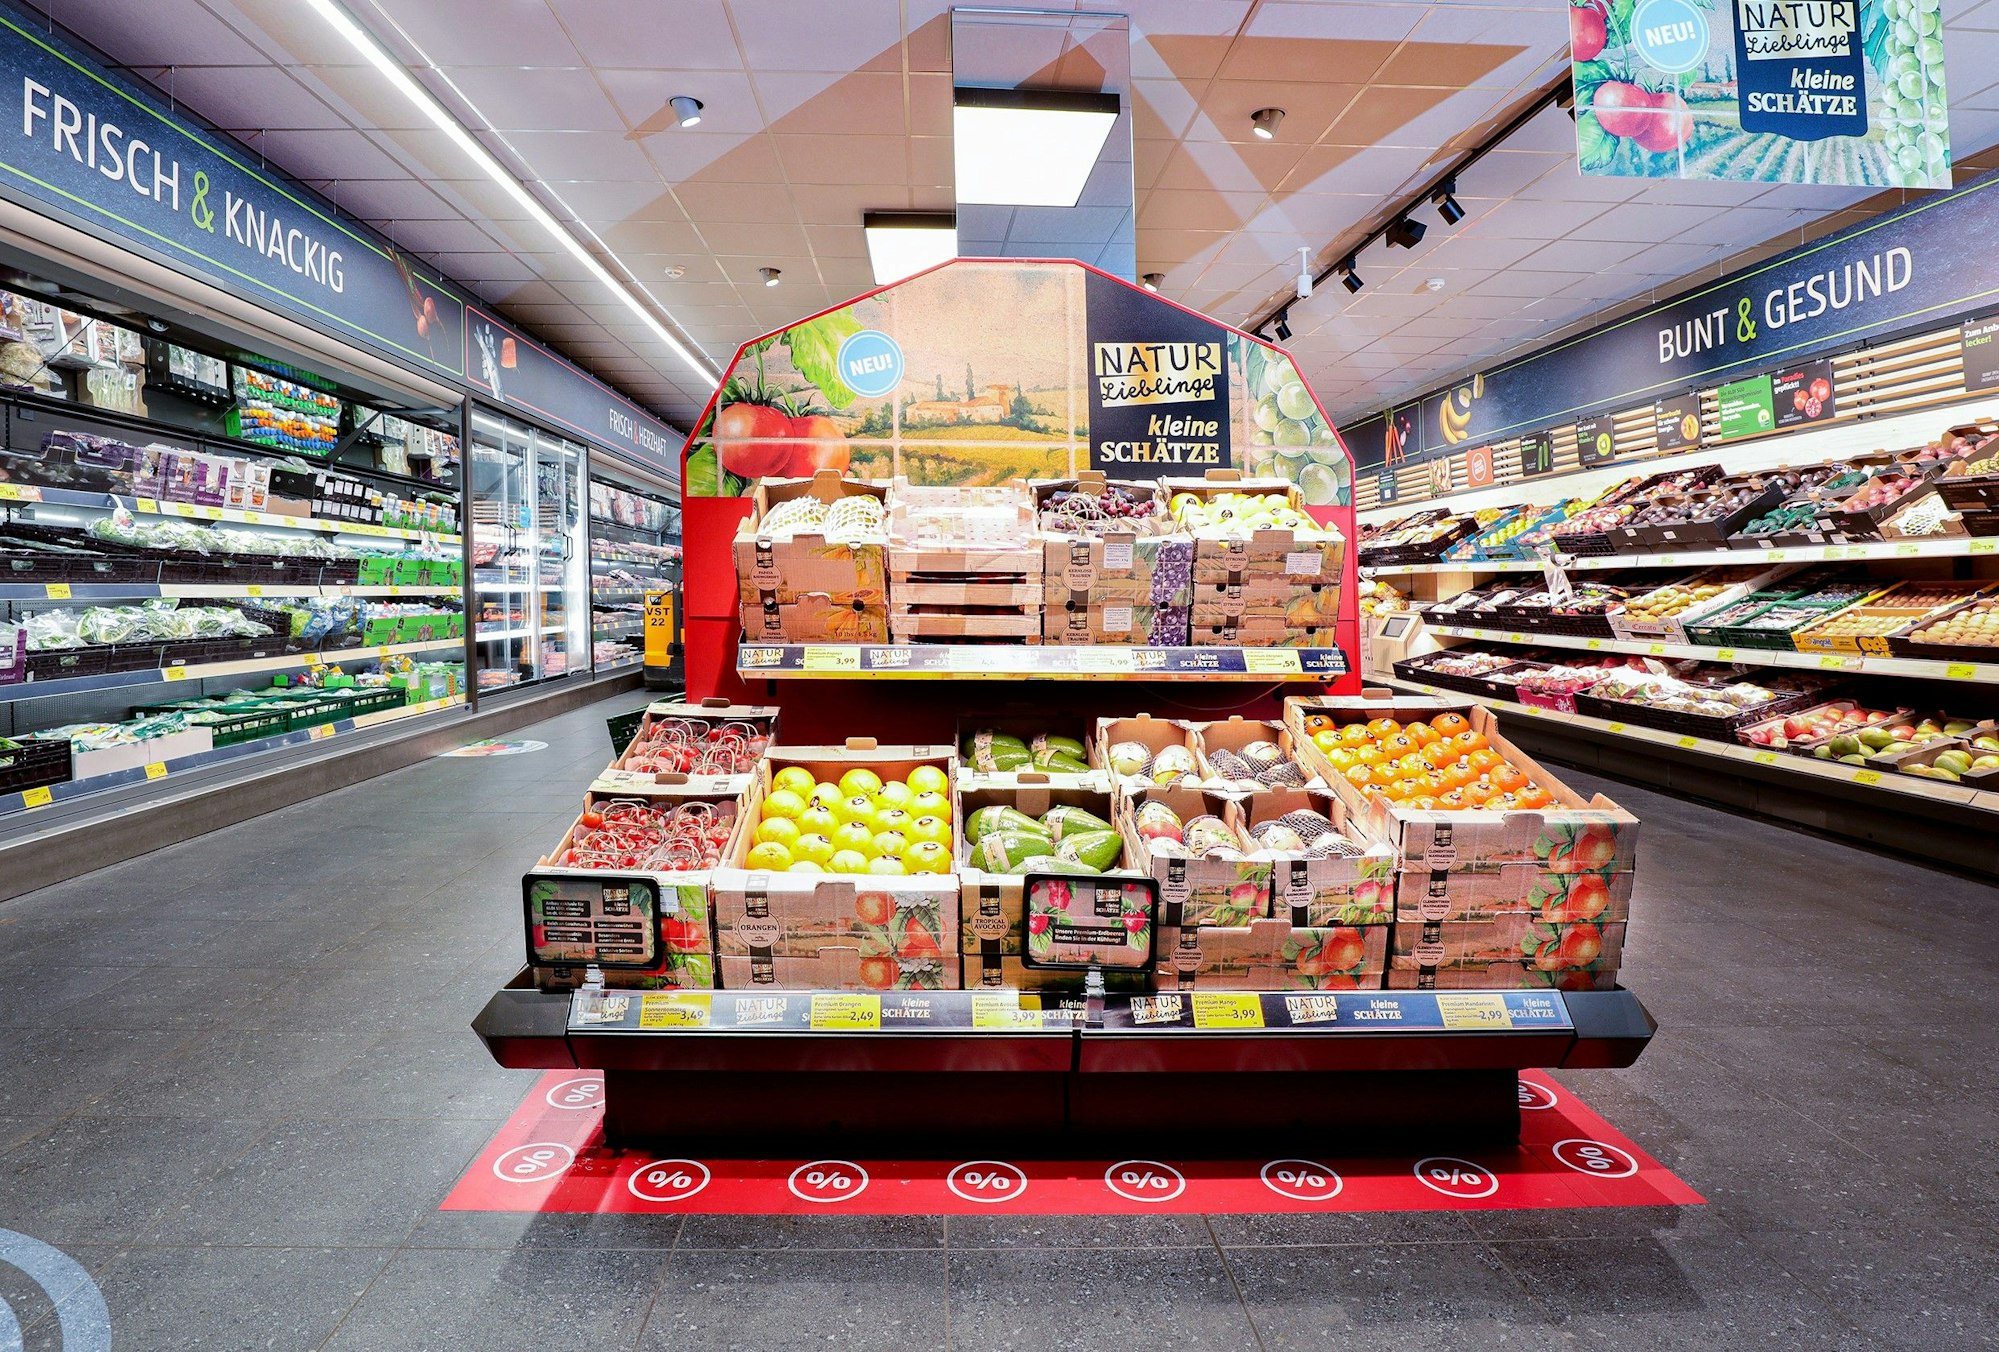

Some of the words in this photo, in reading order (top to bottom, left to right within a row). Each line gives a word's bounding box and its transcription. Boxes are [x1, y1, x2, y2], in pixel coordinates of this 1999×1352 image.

[1744, 1, 1851, 30] NATUR
[1644, 21, 1697, 48] NEU!
[1745, 27, 1850, 55] Lieblinge
[1791, 68, 1855, 91] kleine
[1748, 91, 1857, 116] SCHÄTZE
[23, 76, 179, 212] FRISCH
[191, 170, 215, 234] &
[225, 190, 344, 294] KNACKIG
[1658, 307, 1729, 364] BUNT
[1736, 297, 1757, 342] &
[1764, 246, 1913, 330] GESUND
[1965, 329, 1982, 339] Zum
[1966, 334, 1992, 348] lecker!
[1101, 343, 1217, 373] NATUR
[849, 353, 893, 377] NEU!
[1101, 374, 1214, 402] Lieblinge
[1147, 414, 1219, 437] kleine
[609, 407, 633, 440] FRISCH
[639, 425, 667, 457] HERZHAFT
[1100, 438, 1220, 464] SCHÄTZE
[646, 607, 670, 616] VST
[651, 617, 665, 626] 22
[743, 649, 782, 659] NATUR
[872, 650, 910, 659] NATUR
[1320, 653, 1343, 661] kleine
[1179, 660, 1220, 668] SCHÄTZE
[1306, 660, 1346, 668] SCHÄTZE
[738, 997, 786, 1012] NATUR
[901, 997, 930, 1008] kleine
[1133, 996, 1180, 1010] NATUR
[1288, 996, 1335, 1011] NATUR
[1370, 999, 1399, 1009] kleine
[1523, 998, 1551, 1008] kleine
[680, 1010, 704, 1020] 3,49
[850, 1011, 874, 1021] 2,49
[881, 1007, 931, 1018] SCHÄTZE
[1012, 1011, 1036, 1022] 3,99
[1232, 1009, 1256, 1021] 3,99
[1353, 1009, 1403, 1020] SCHÄTZE
[1479, 1010, 1502, 1021] 2,99
[1507, 1007, 1555, 1018] SCHÄTZE
